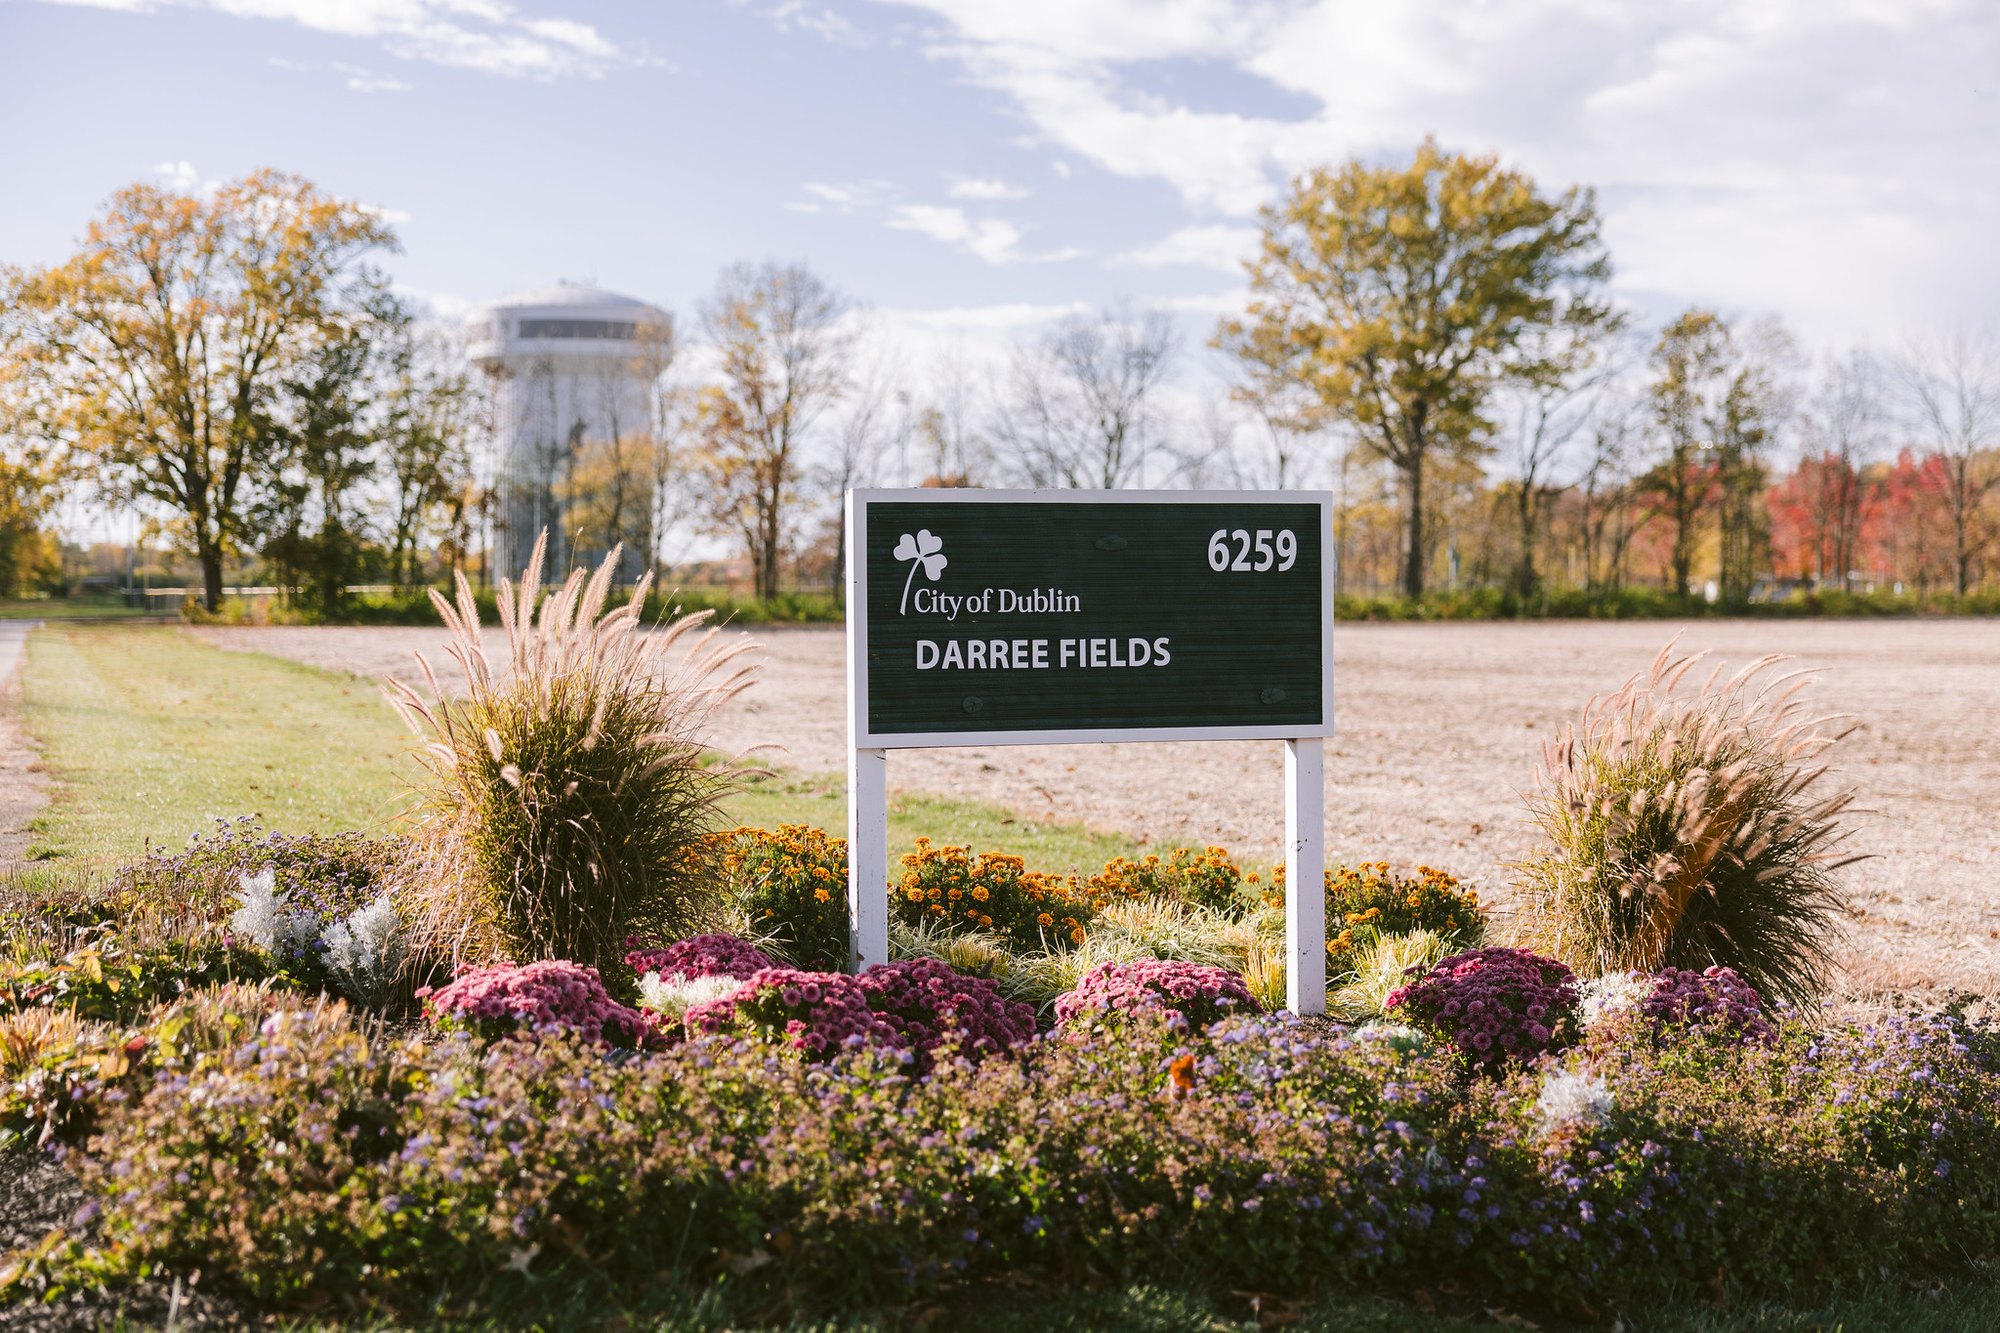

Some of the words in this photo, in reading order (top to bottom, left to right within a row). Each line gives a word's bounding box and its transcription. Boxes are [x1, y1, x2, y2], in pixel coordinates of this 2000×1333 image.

[1207, 528, 1298, 572] 6259
[914, 588, 962, 621] City
[965, 588, 993, 613] of
[997, 587, 1081, 613] Dublin
[916, 639, 1049, 670] DARREE
[1059, 637, 1171, 668] FIELDS
